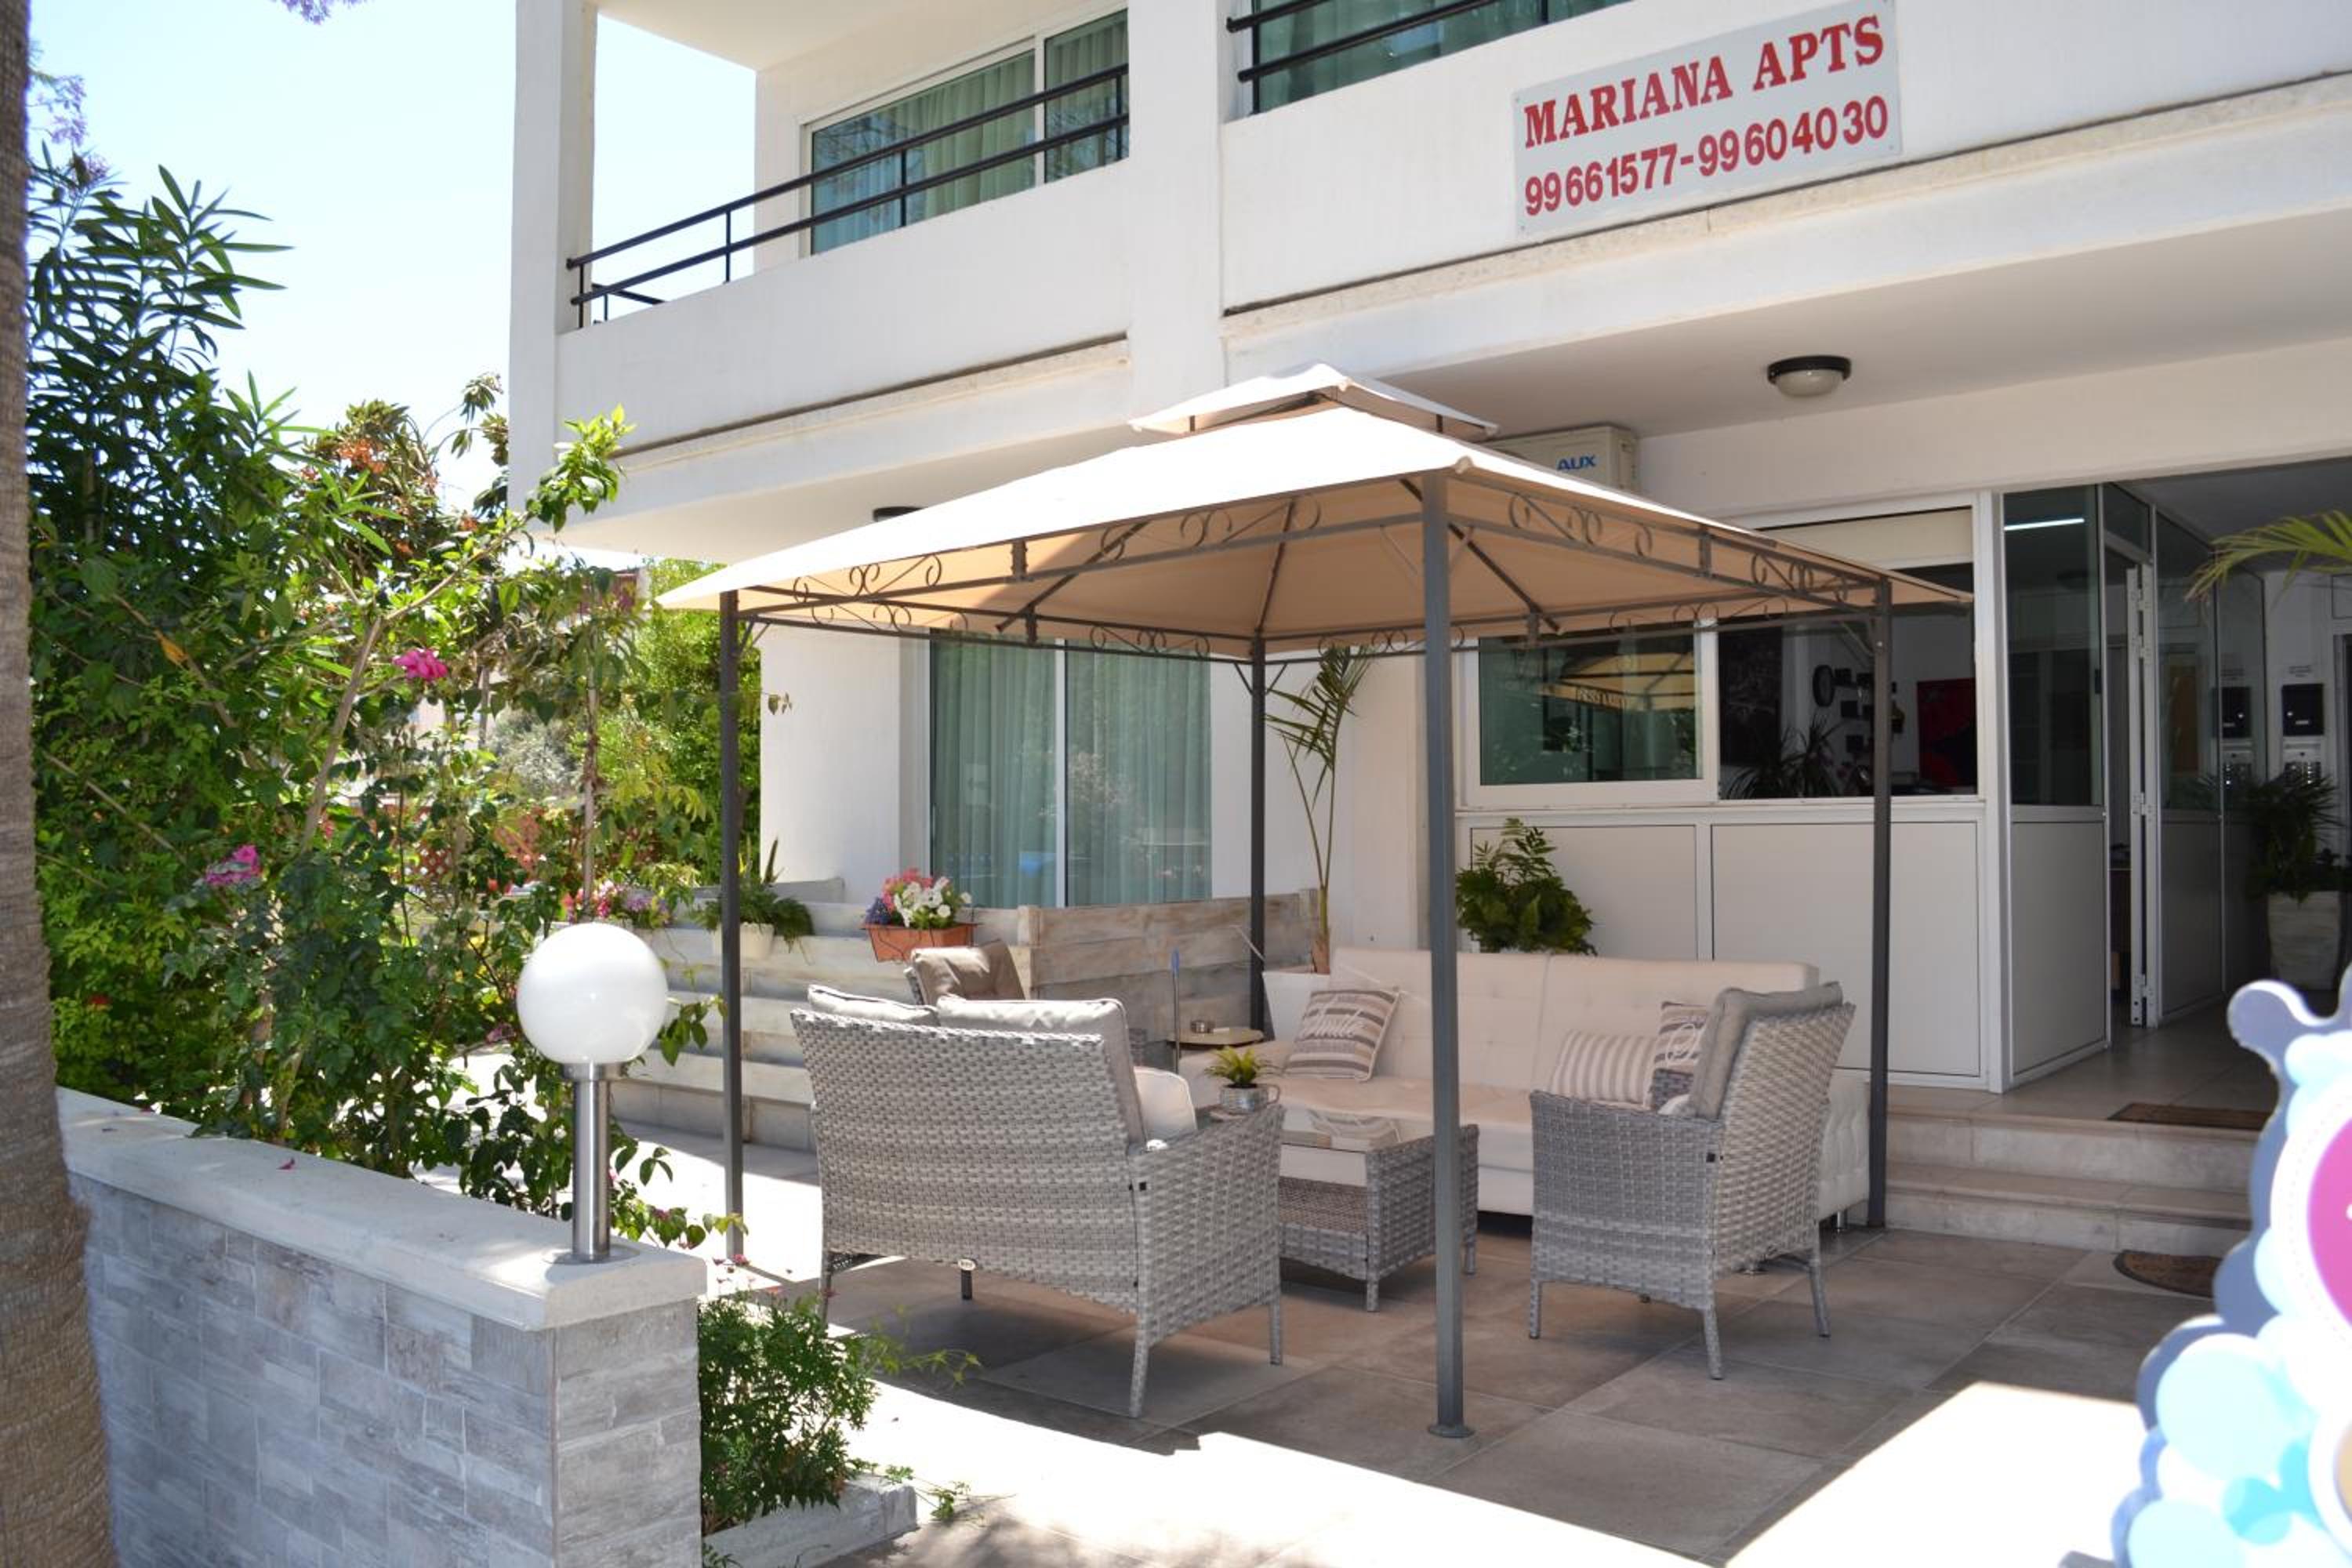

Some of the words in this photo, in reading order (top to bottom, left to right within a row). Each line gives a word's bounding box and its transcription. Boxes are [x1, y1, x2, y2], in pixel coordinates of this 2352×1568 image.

[1524, 56, 1733, 148] MARIANA
[1753, 16, 1884, 92] APTS
[1525, 96, 1888, 216] 99661577-99604030
[1557, 455, 1596, 470] AUX
